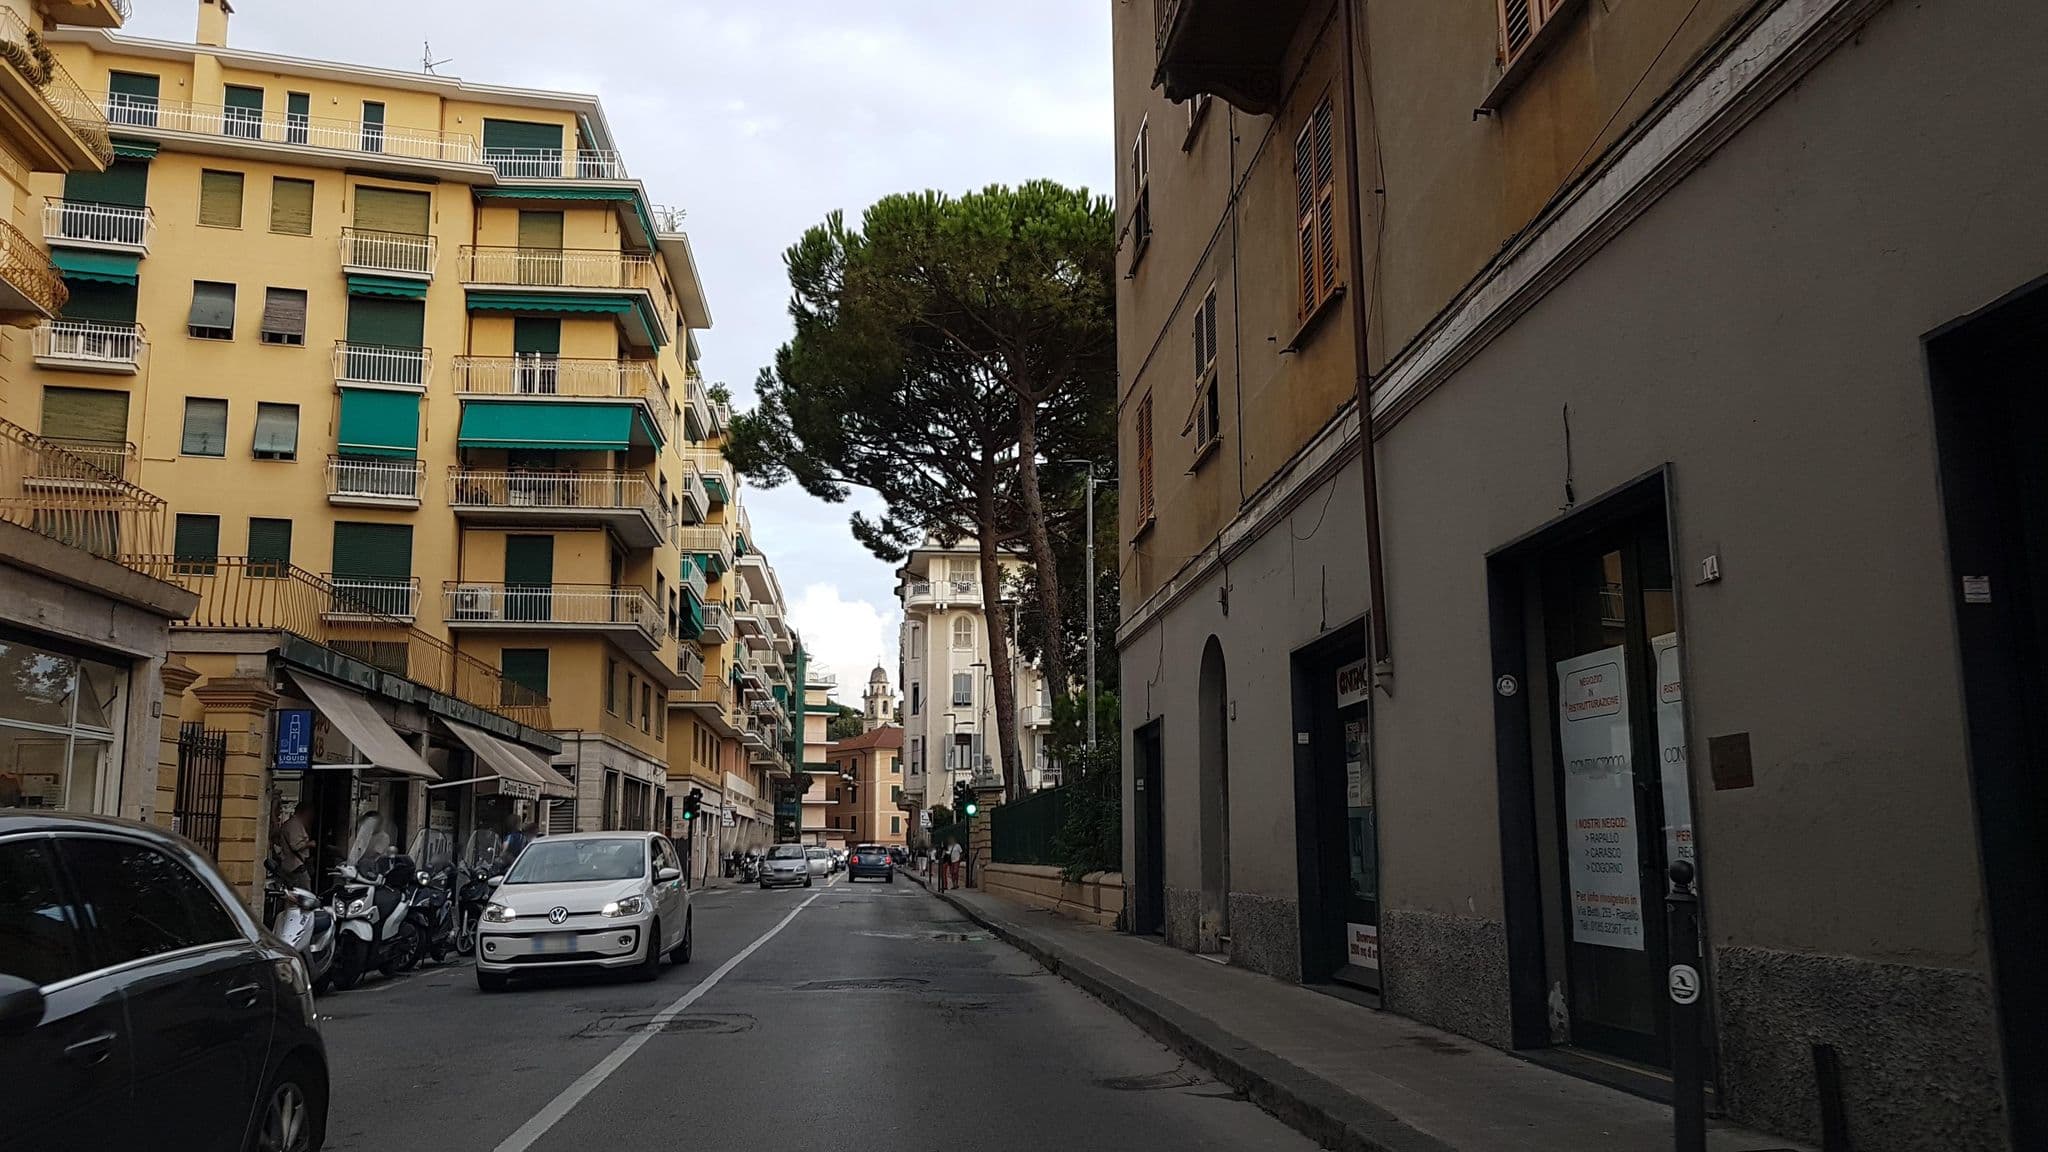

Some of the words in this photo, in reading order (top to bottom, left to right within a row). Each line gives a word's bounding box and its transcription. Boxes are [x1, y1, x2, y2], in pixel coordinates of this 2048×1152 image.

[1579, 674, 1602, 687] NEGOZIO
[1568, 696, 1619, 713] RISTRUTTURAZIONE
[1579, 818, 1600, 829] NOSTRI
[1590, 832, 1619, 843] RAPALLO
[1591, 847, 1621, 858] CARASCO
[1591, 862, 1623, 873] COGORNO
[1576, 905, 1586, 916] Via
